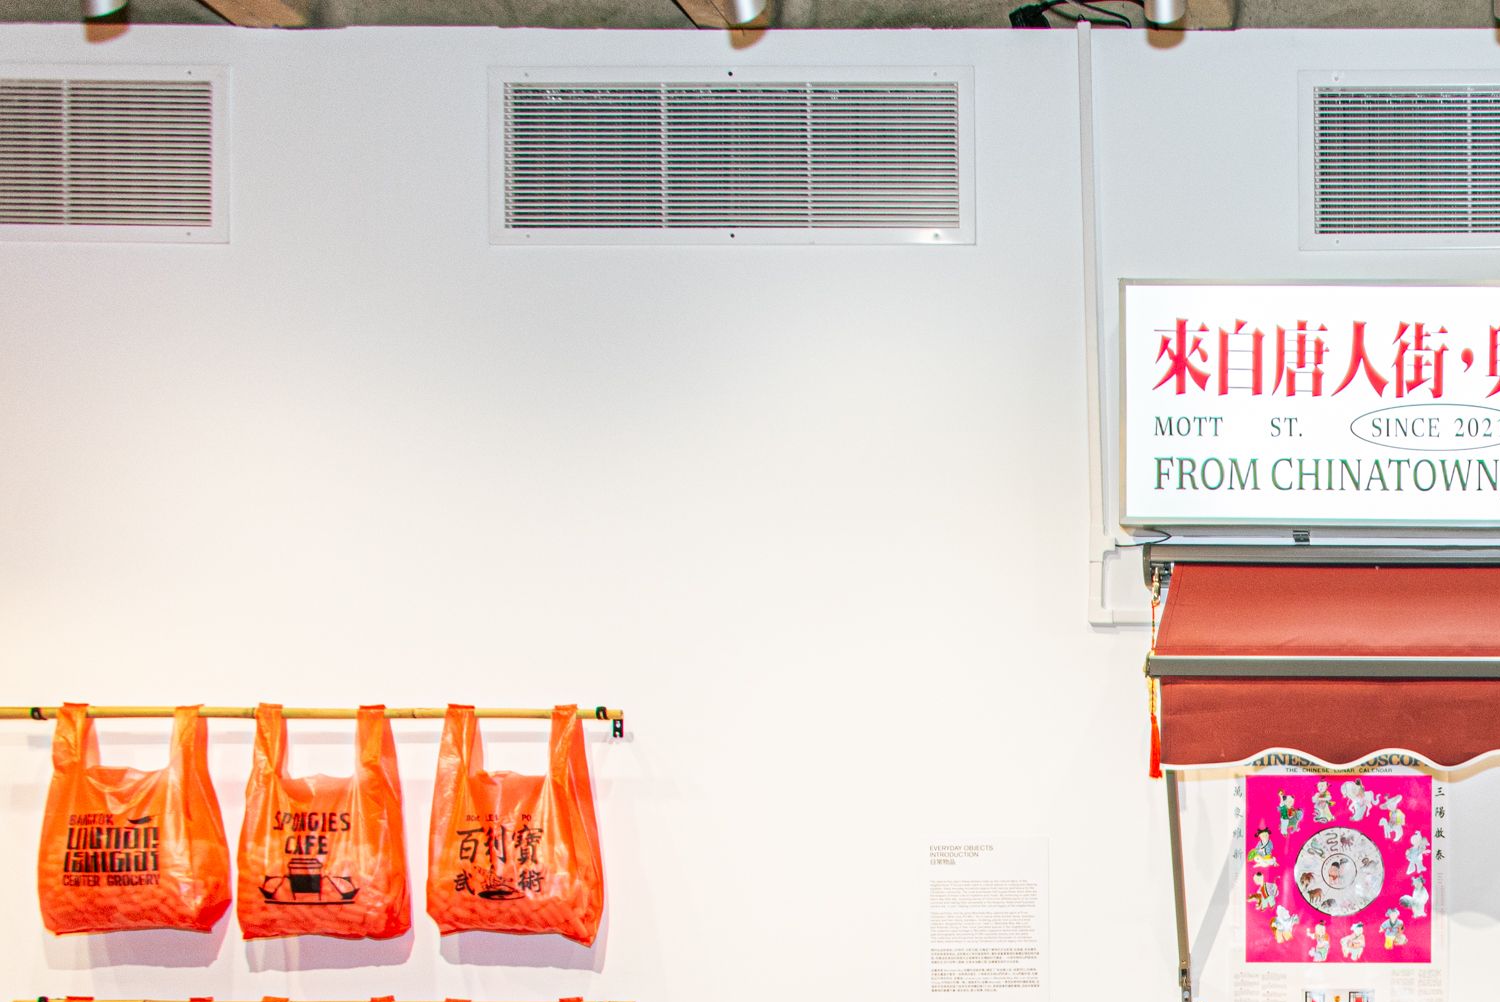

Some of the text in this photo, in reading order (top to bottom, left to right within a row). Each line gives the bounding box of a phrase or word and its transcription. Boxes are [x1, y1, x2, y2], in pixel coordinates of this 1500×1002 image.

[1154, 416, 1224, 437] MOTT
[1270, 417, 1303, 438] ST.
[1371, 417, 1440, 438] SINCE
[1153, 456, 1262, 492] FROM
[273, 811, 350, 832] SPONGIES
[284, 834, 328, 855] CAFE
[456, 824, 544, 865] 百利寶
[63, 874, 160, 887] CENTER GROCERY
